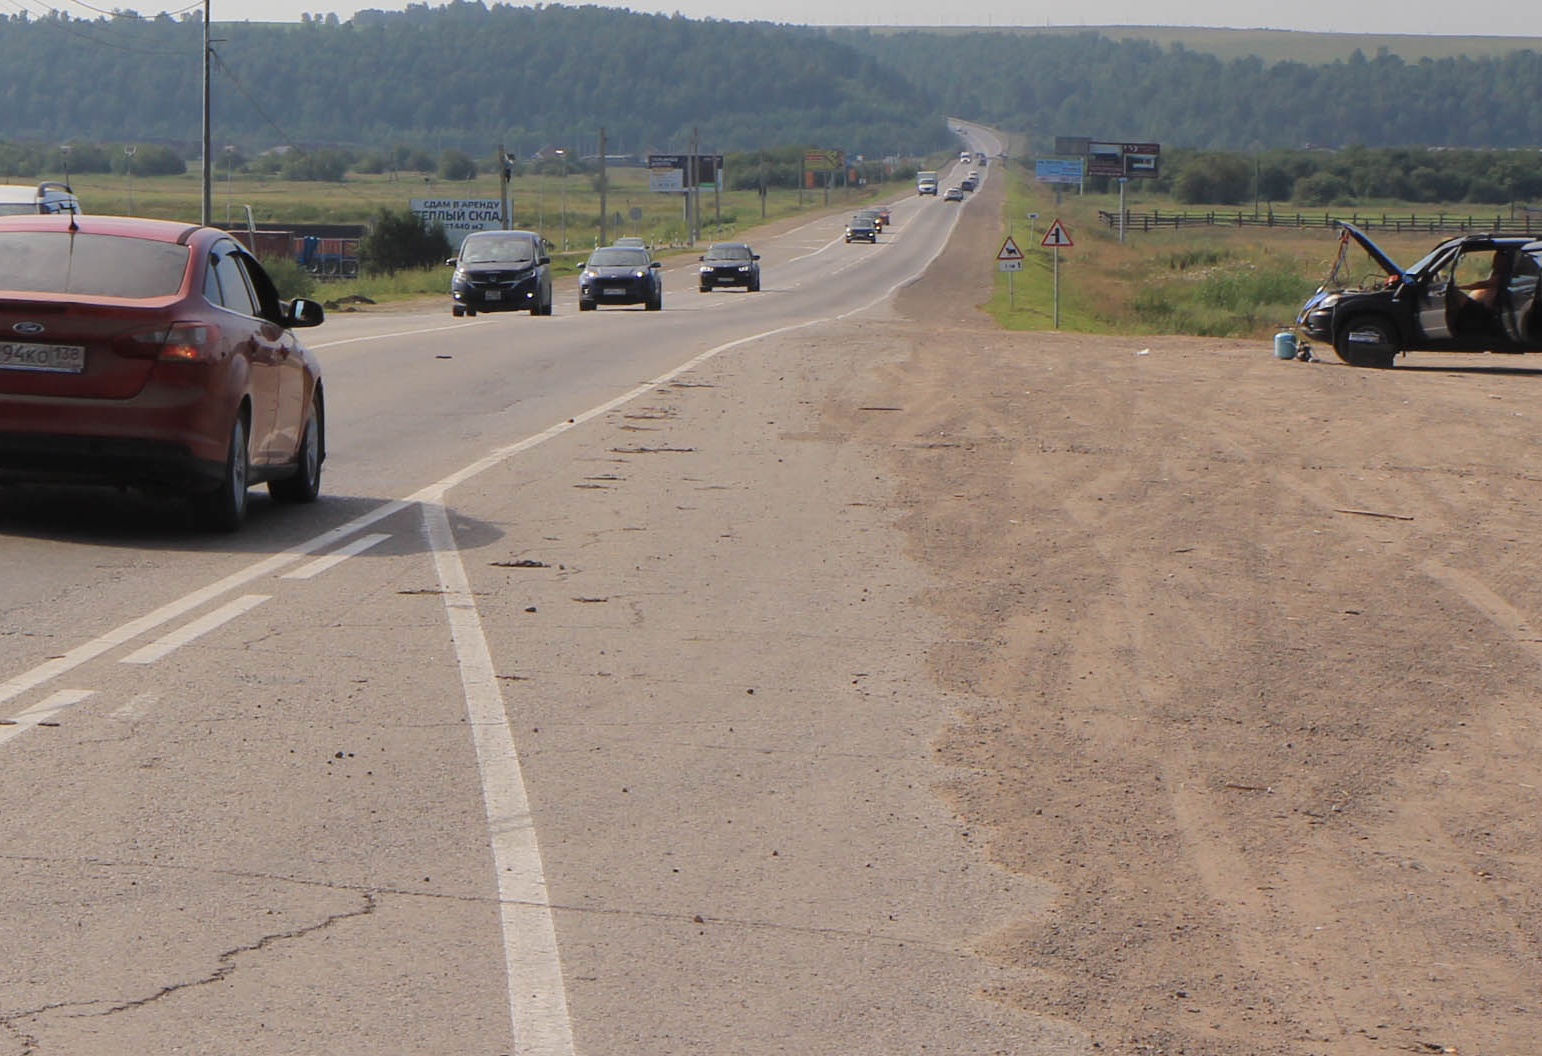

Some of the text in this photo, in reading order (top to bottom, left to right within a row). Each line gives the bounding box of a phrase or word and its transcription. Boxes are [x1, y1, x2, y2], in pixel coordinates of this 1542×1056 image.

[423, 201, 451, 209] СДАМ
[461, 201, 500, 209] АРЕНДУ
[54, 346, 80, 361] 138
